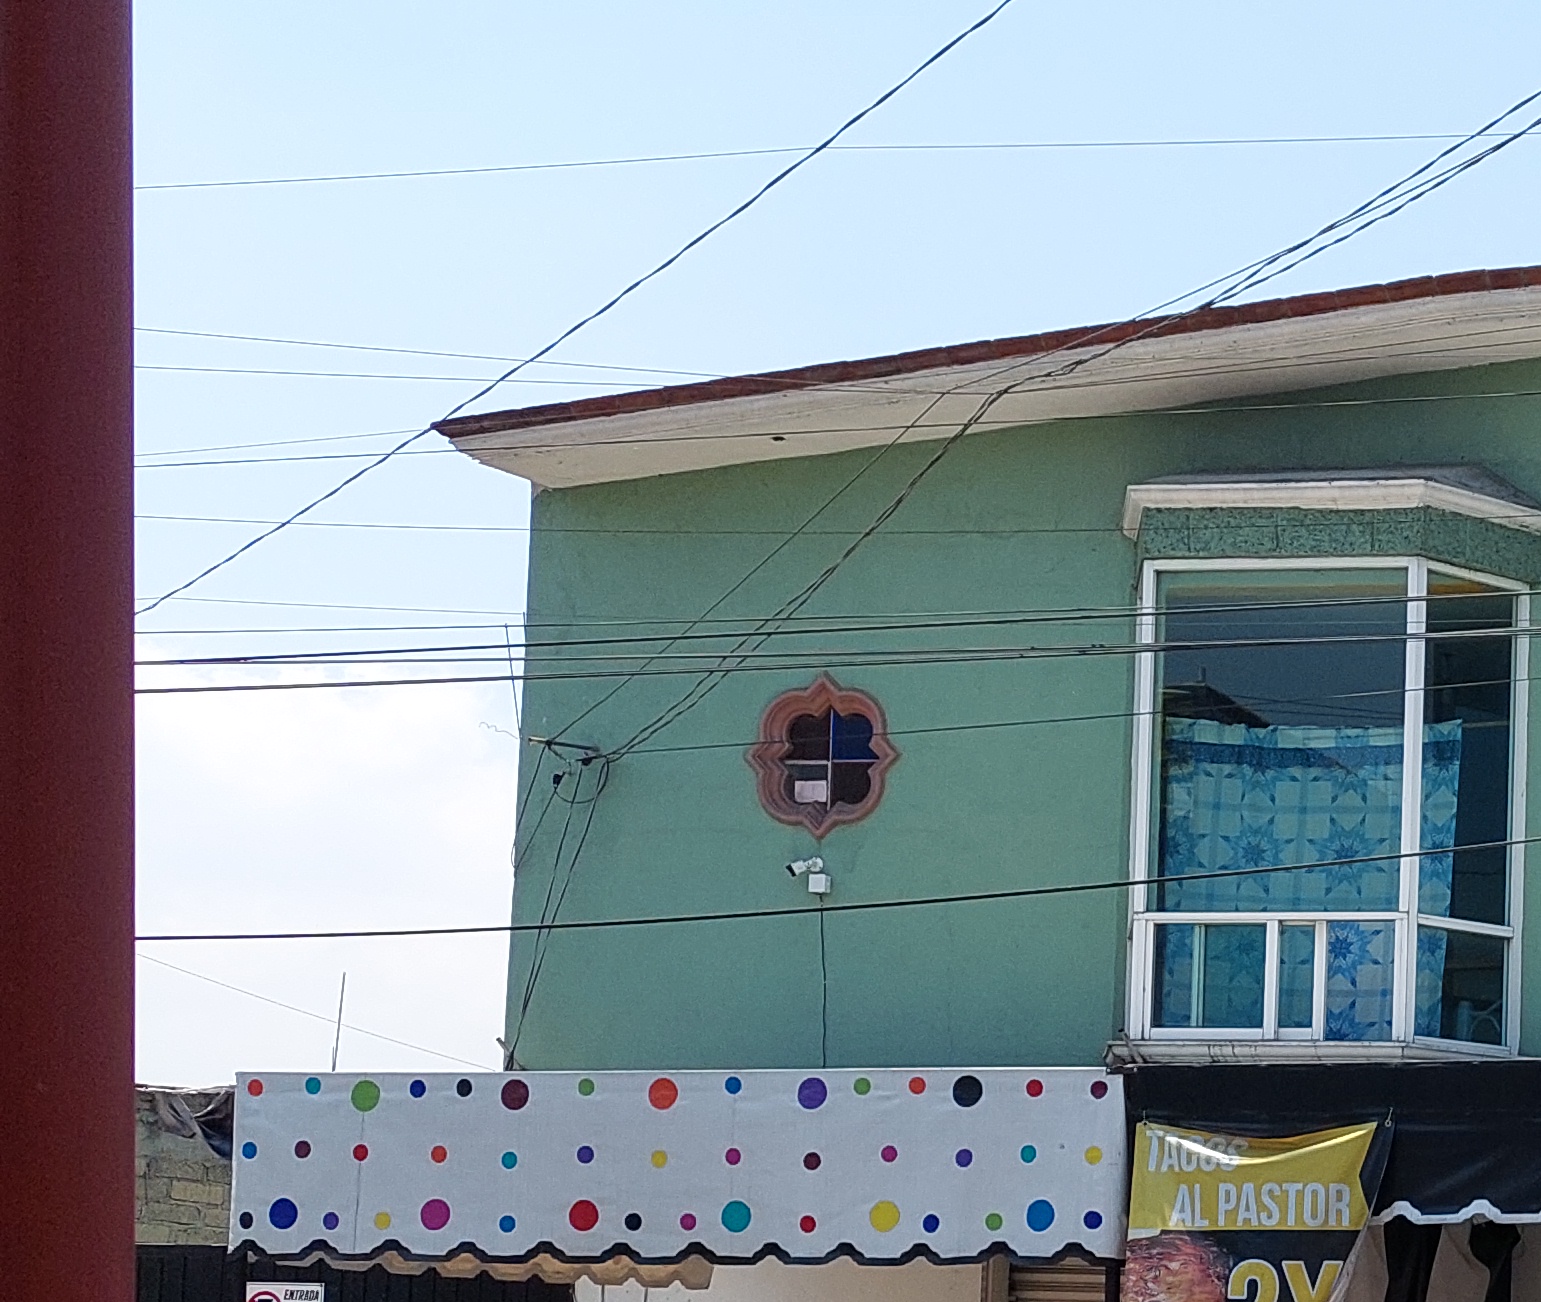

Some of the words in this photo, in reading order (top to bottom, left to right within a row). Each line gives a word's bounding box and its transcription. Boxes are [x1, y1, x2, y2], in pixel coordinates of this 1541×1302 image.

[1145, 1130, 1247, 1172] TACOS
[1170, 1184, 1209, 1227] AL
[1218, 1182, 1350, 1227] PASTOR
[283, 1289, 319, 1301] ENTRADA
